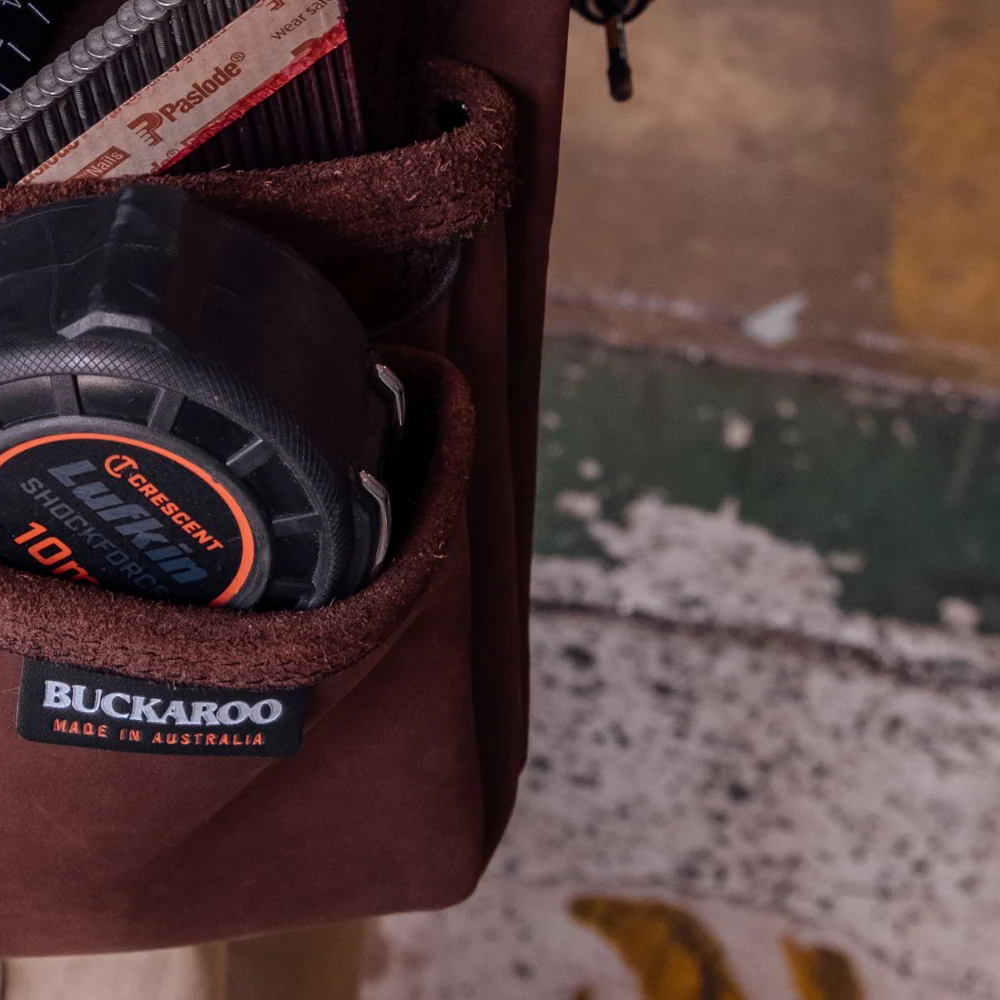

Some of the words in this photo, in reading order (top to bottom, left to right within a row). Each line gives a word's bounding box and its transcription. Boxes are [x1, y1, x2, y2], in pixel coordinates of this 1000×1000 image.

[270, 13, 307, 40] wear
[47, 459, 208, 584] Lufkin
[127, 473, 225, 551] CRESCENT
[42, 680, 283, 727] BUCKAROO
[53, 718, 109, 738] MADE
[119, 728, 141, 742] IN
[152, 731, 264, 746] AUSTRALIA
